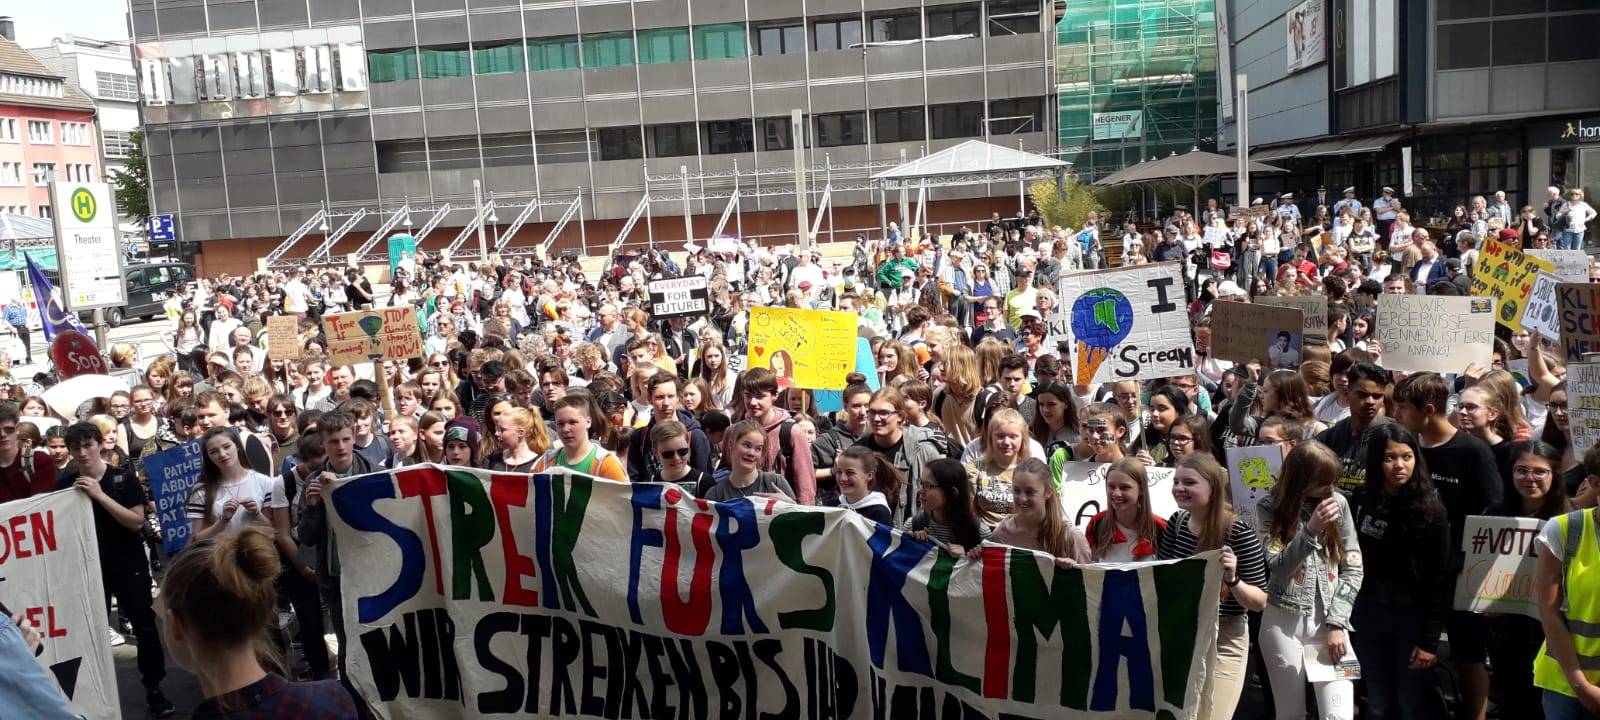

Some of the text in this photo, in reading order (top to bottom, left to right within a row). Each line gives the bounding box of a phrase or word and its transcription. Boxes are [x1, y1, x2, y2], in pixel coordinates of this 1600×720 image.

[1095, 114, 1132, 124] HEGENER
[77, 195, 92, 215] H
[74, 234, 102, 245] Theater
[1485, 239, 1502, 257] We
[1504, 250, 1525, 267] will
[1525, 261, 1540, 273] go
[1480, 257, 1491, 273] to
[654, 279, 700, 290] EVERYDAY
[667, 291, 688, 302] FOR
[1147, 277, 1176, 313] I
[655, 299, 705, 314] FUTURE!
[1380, 296, 1446, 312] WAS WIR
[325, 316, 355, 331] Time
[384, 308, 410, 324] STOP
[1379, 312, 1471, 330] ERGEBNISSE
[1442, 331, 1461, 343] IST
[1464, 330, 1493, 344] ERST
[388, 340, 420, 358] NOW!
[1407, 345, 1450, 357] ANFANG!
[163, 457, 204, 479] RATHE
[1431, 472, 1459, 484] Marvin
[161, 509, 178, 524] AT
[332, 468, 600, 623] STREIK
[866, 523, 1208, 720] KLIMA!
[360, 608, 465, 708] WIR
[474, 612, 708, 720] STREIKEN
[705, 639, 800, 720] BIS
